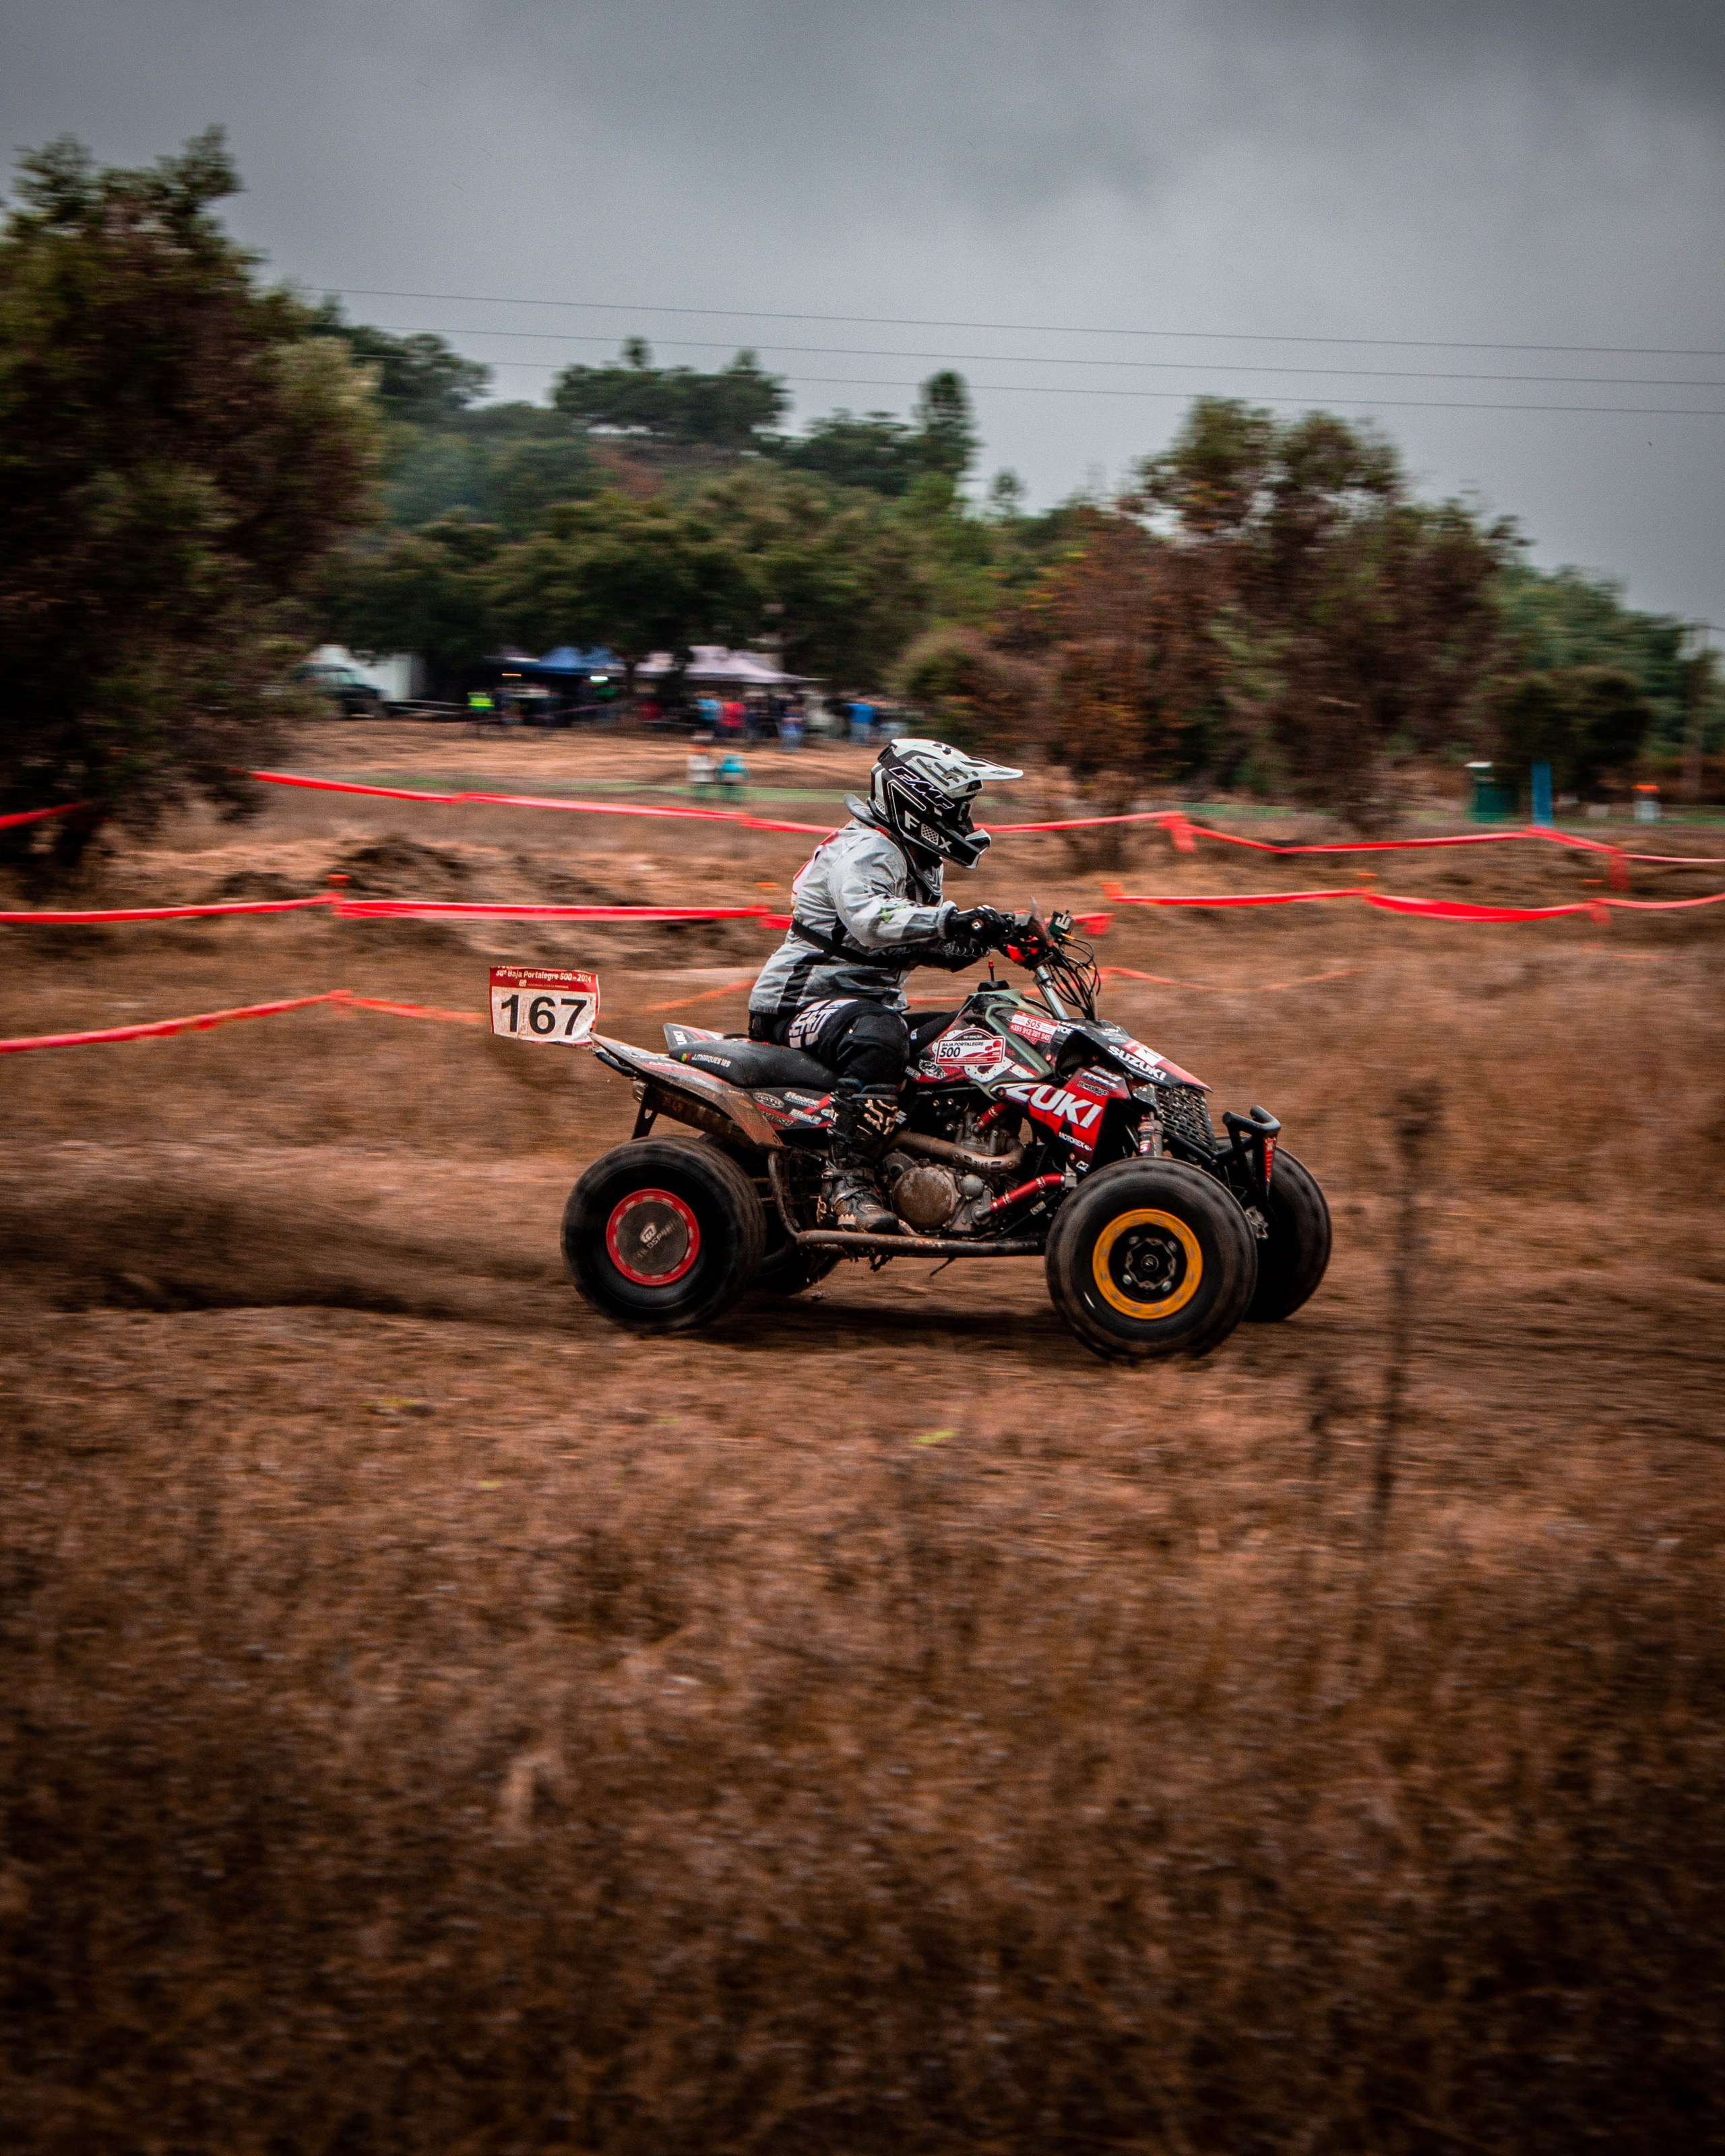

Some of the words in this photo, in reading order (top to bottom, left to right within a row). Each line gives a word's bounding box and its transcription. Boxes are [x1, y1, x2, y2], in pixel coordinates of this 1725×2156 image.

[508, 970, 522, 978] Baja
[524, 971, 559, 982] Portalegre
[560, 973, 572, 981] 500
[577, 974, 592, 983] 2024
[501, 994, 588, 1036] 167
[1026, 1019, 1041, 1029] SOS
[939, 1047, 961, 1058] 500
[1108, 1045, 1166, 1081] SUZUKI
[1059, 1132, 1085, 1148] MOTOREX
